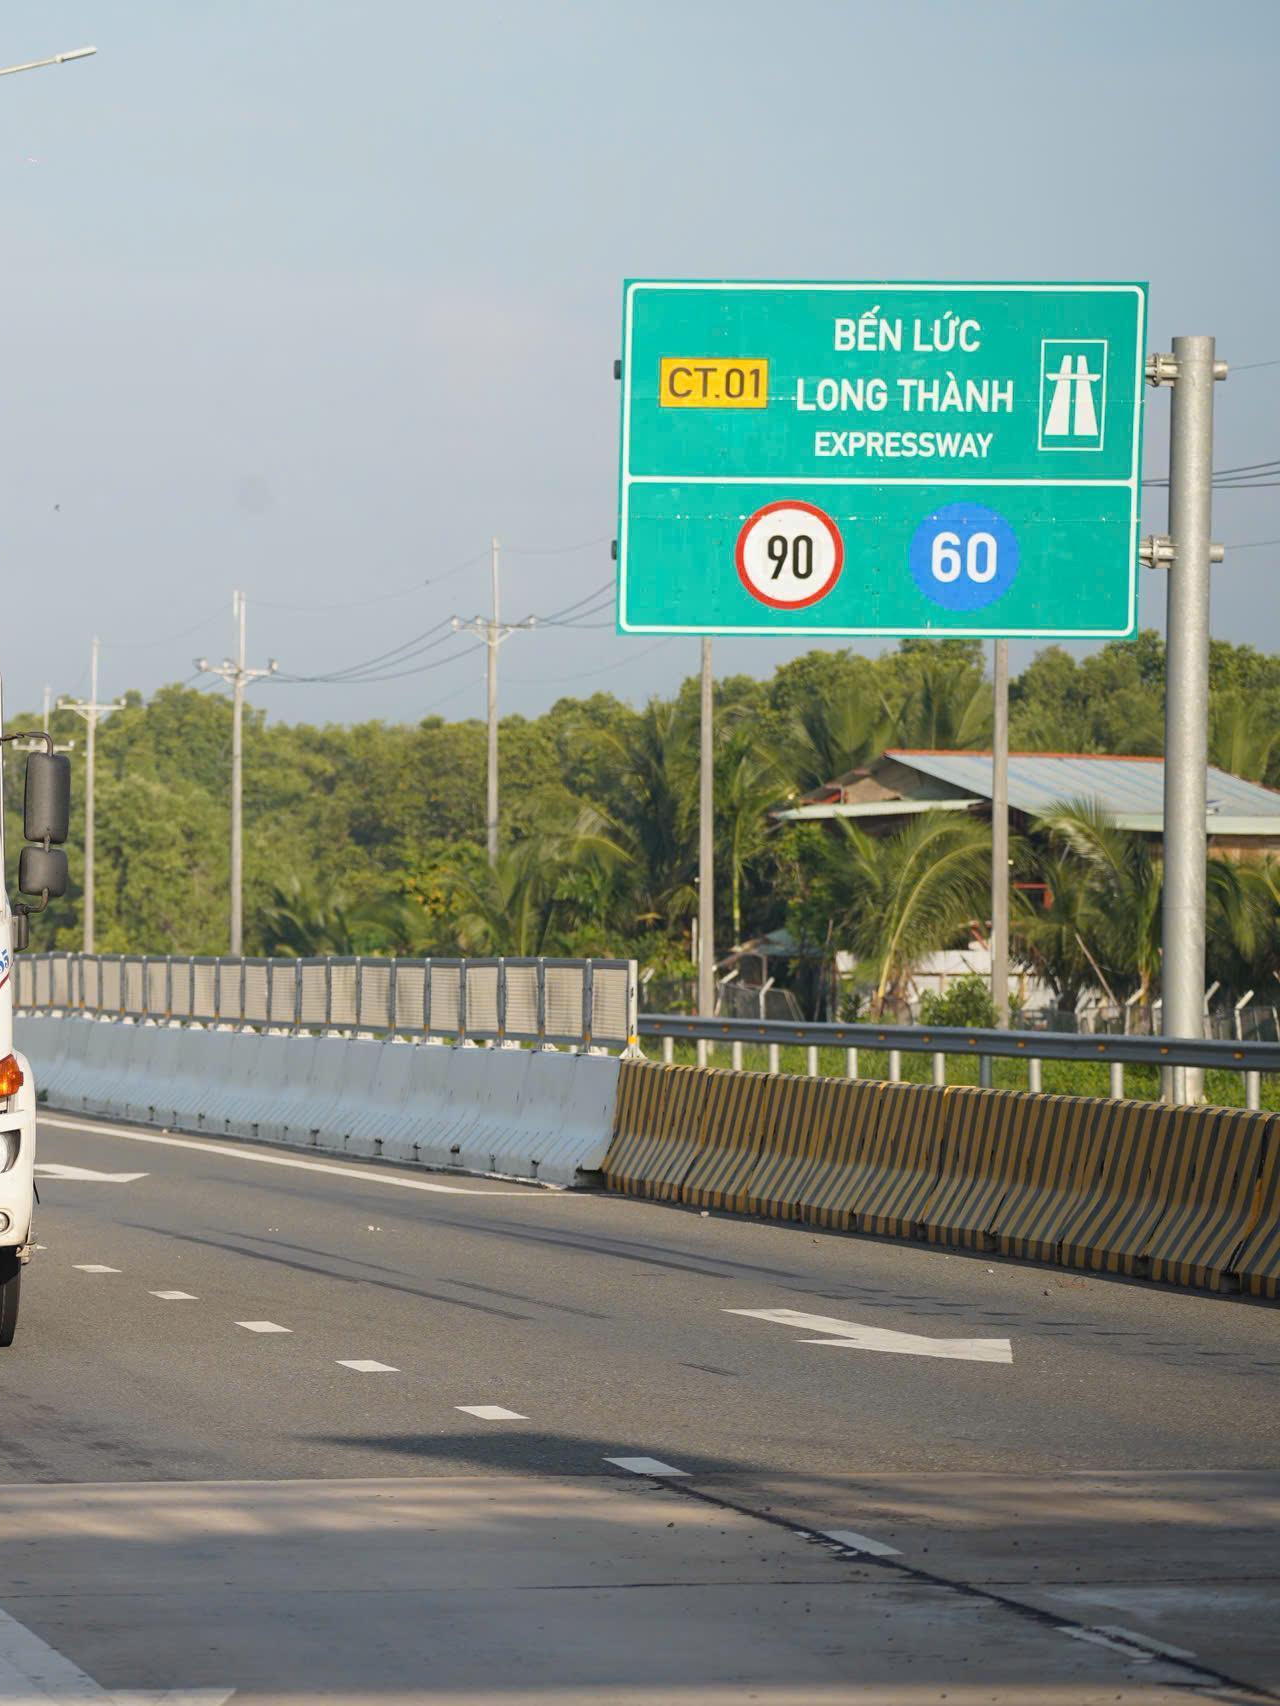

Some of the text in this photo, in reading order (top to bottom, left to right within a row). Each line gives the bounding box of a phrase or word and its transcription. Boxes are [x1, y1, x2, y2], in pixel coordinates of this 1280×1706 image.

[834, 305, 981, 352] BẾN LỨC
[668, 367, 761, 398] CT.01
[796, 371, 1014, 412] LONG THÀNH
[814, 431, 993, 458] EXPRESSWAY
[767, 535, 813, 580] 90
[931, 532, 998, 583] 60
